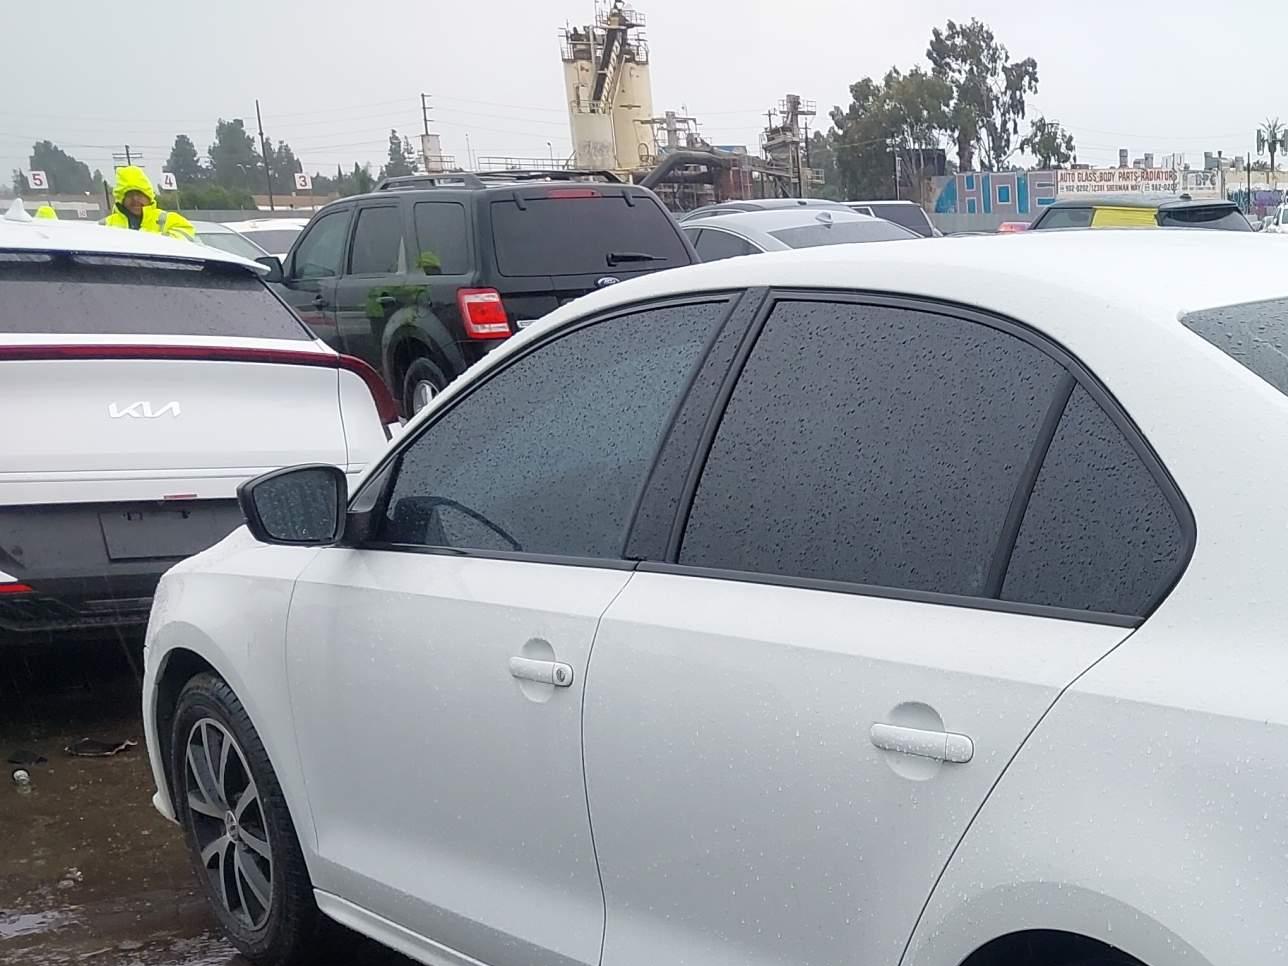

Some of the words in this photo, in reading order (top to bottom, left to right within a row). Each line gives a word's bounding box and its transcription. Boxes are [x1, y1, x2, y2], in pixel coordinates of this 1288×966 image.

[31, 173, 43, 186] 5
[164, 174, 173, 187] 4
[298, 175, 307, 187] 3
[1060, 171, 1076, 182] AUTO
[1106, 184, 1129, 192] SHERMAN
[108, 400, 181, 419] KIA
